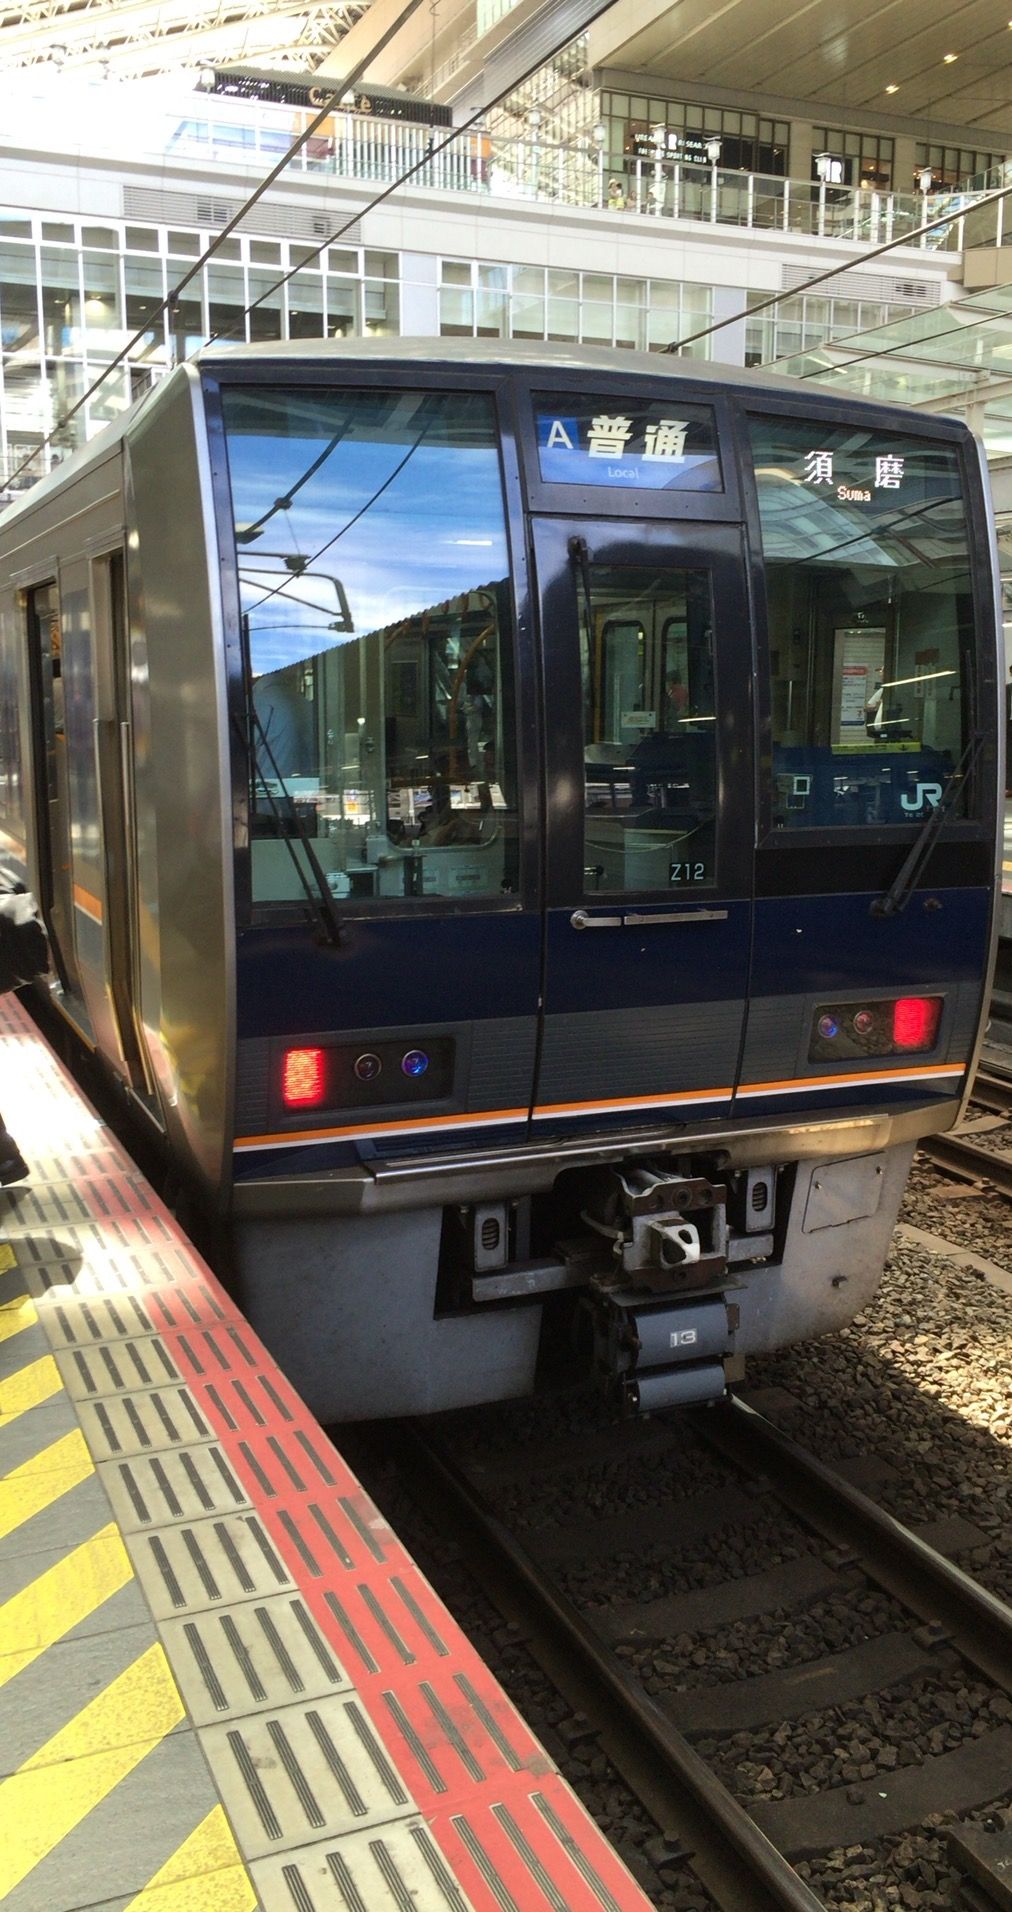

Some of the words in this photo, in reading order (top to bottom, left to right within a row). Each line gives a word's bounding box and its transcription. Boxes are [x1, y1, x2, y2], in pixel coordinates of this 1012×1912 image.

[547, 420, 574, 449] A
[587, 414, 690, 463] 普通
[607, 466, 640, 479] Local
[804, 450, 905, 488] 須磨
[837, 485, 872, 502] Suma
[900, 782, 943, 810] JR
[671, 863, 705, 880] Z12
[670, 1329, 697, 1347] 13
